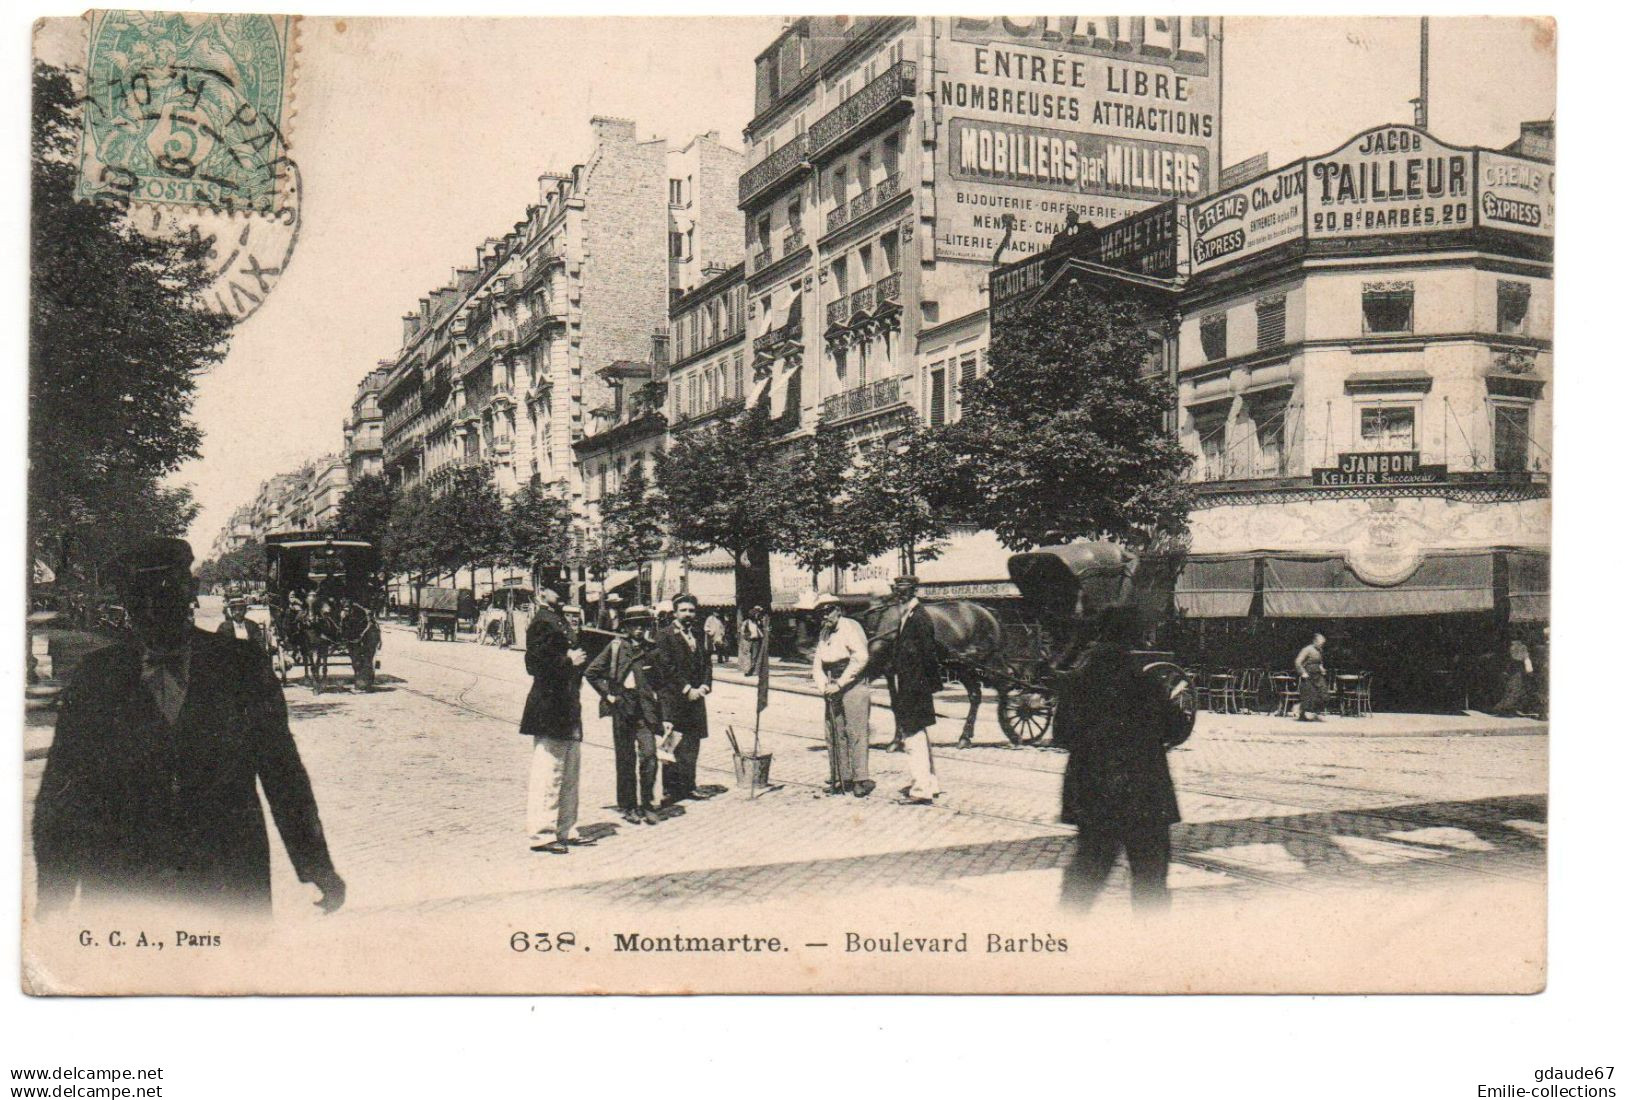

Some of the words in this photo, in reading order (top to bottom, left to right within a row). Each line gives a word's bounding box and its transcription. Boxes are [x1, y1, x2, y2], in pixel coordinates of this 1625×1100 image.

[975, 47, 1086, 88] ENTRÉE
[1107, 66, 1188, 101] LIBRE
[941, 80, 1080, 122] NOMBREUSES
[1093, 100, 1213, 138] ATTRACTIONS
[1359, 130, 1422, 154] JACOB
[960, 127, 1078, 186] MOBILIERS
[1080, 154, 1104, 188] par
[1105, 143, 1200, 197] MILLIERS
[135, 179, 219, 201] POSTES
[1313, 156, 1468, 206] TAILLEUR
[957, 192, 1032, 210] BIJOUTERIE
[1484, 194, 1539, 223] EXPRESS
[946, 234, 993, 249] LITERIE
[1196, 231, 1241, 262] EXPRESS
[1343, 455, 1413, 473] JAMBON
[1321, 471, 1376, 485] KELLER
